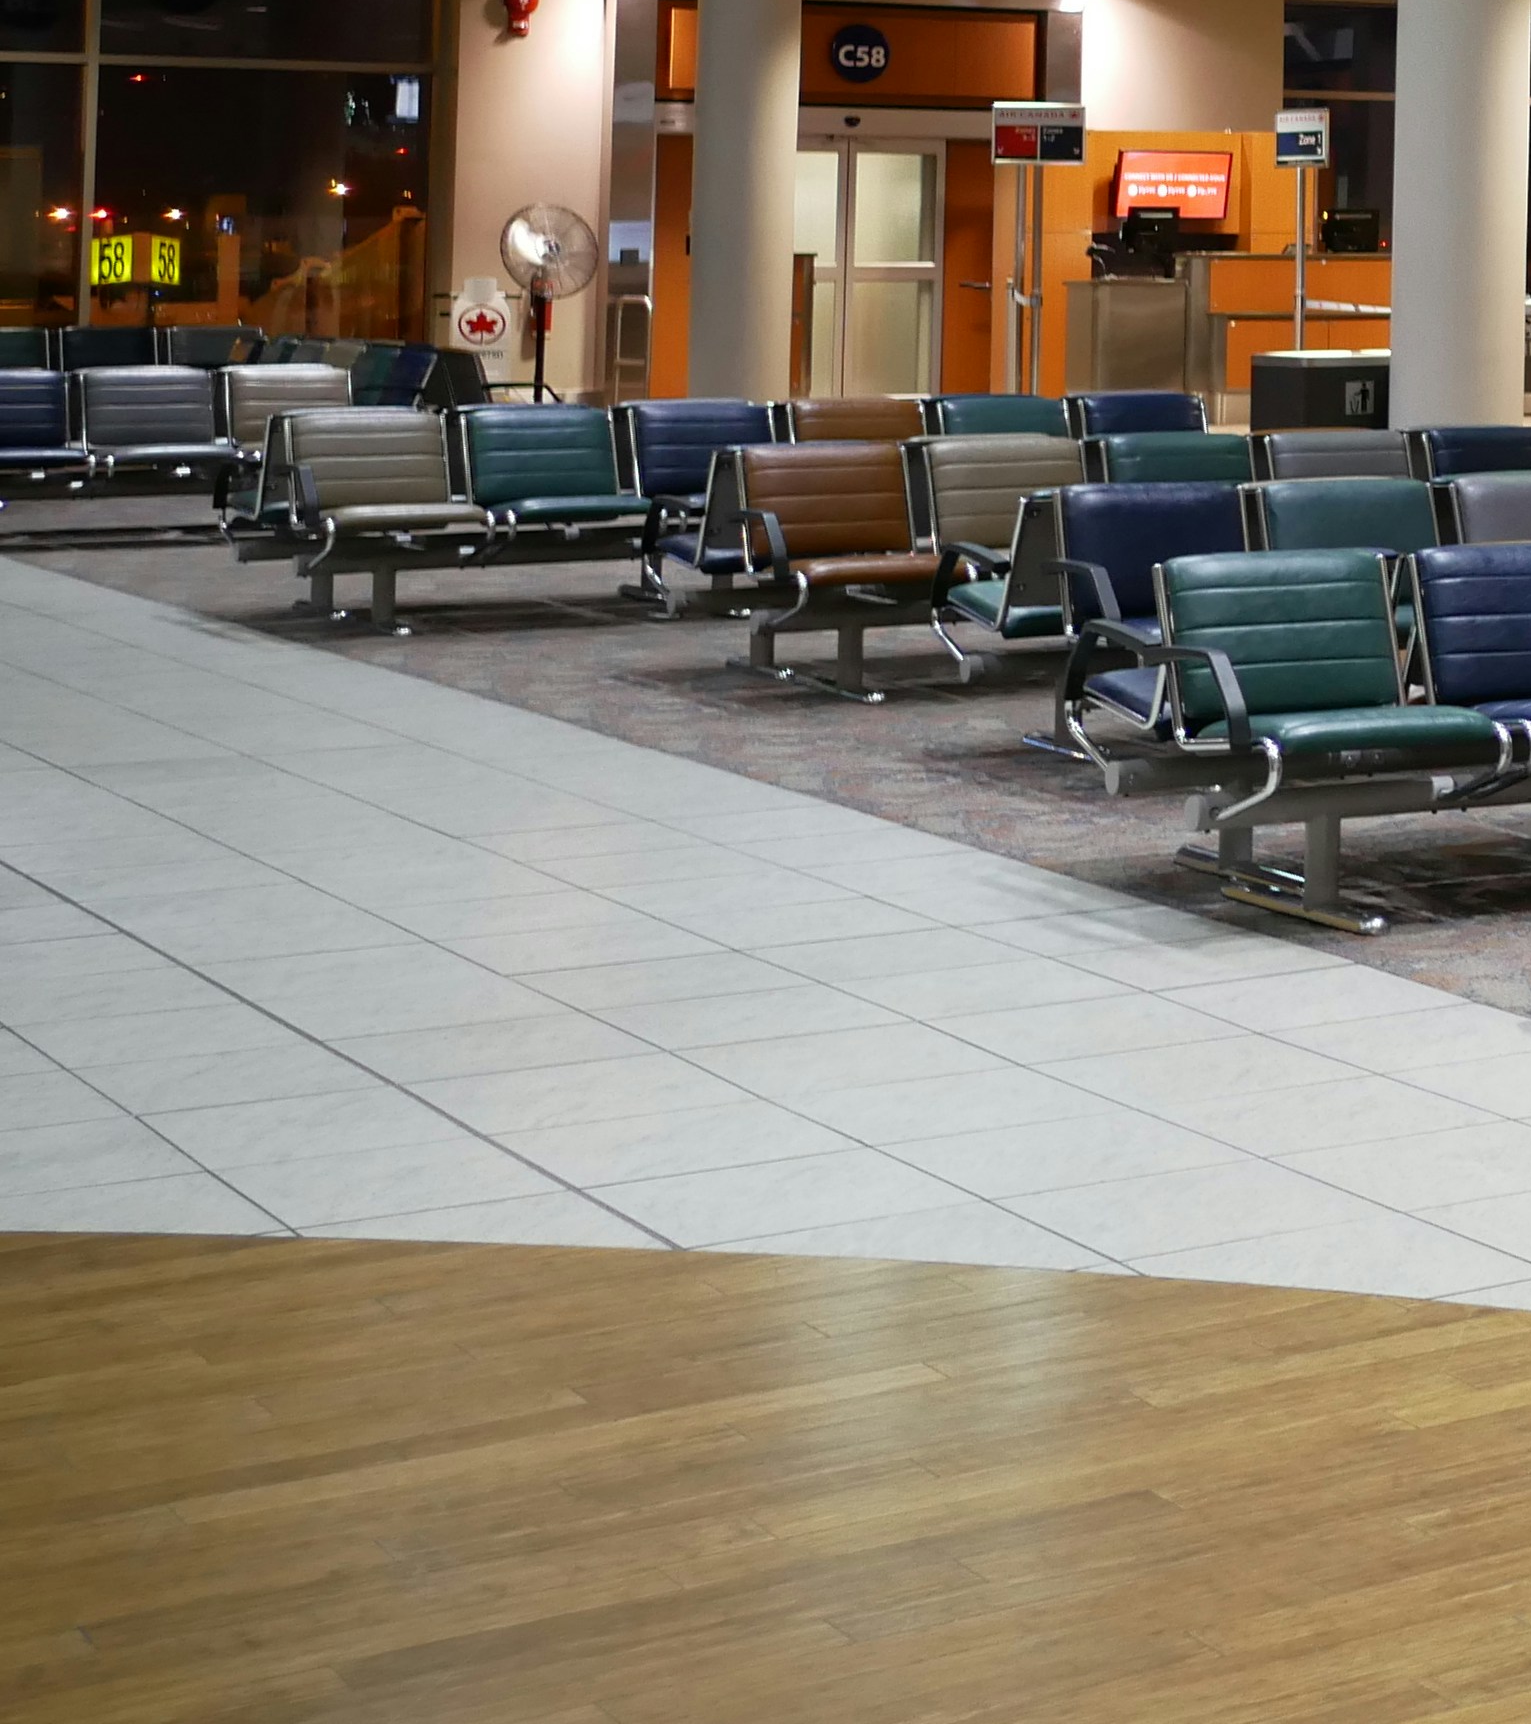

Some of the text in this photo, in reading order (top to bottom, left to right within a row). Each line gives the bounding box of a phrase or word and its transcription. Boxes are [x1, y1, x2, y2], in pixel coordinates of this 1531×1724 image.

[837, 43, 886, 70] C58
[1298, 133, 1316, 146] Zone
[99, 242, 125, 280] 58
[158, 242, 176, 280] 58
